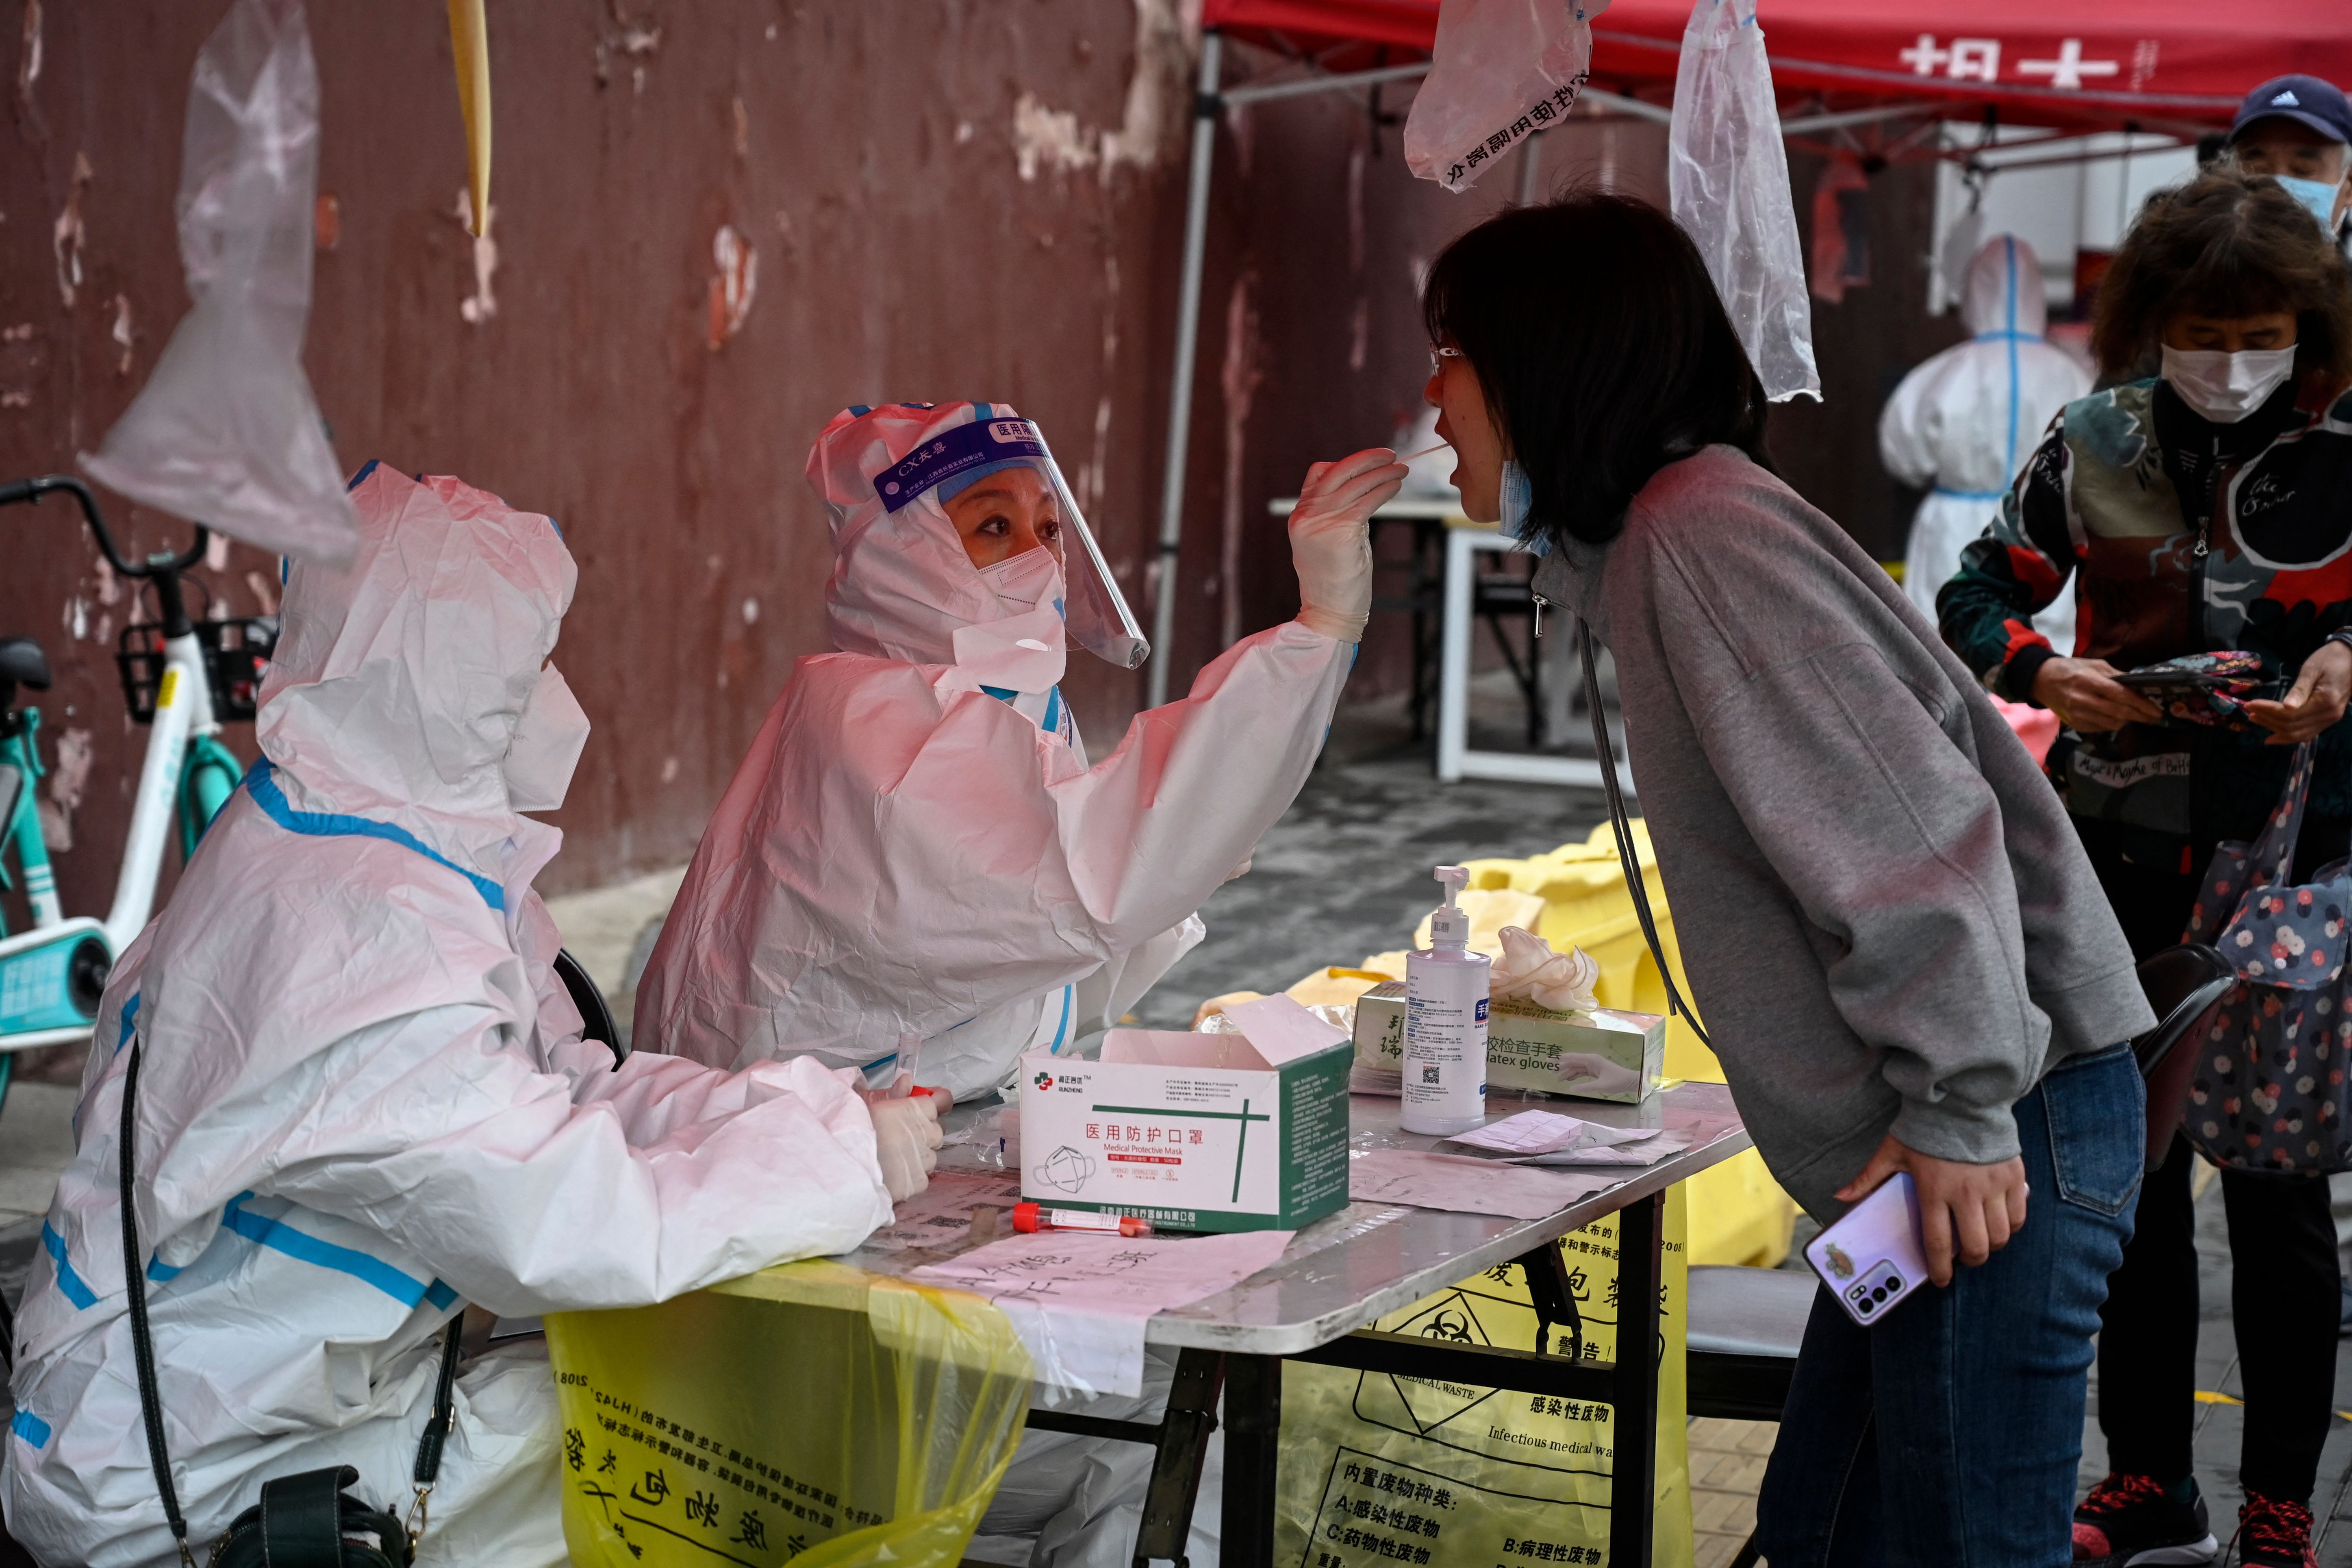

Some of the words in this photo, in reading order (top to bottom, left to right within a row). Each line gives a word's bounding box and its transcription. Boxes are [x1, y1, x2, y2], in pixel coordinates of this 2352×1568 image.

[1486, 1051, 1516, 1066] latex
[1520, 1057, 1560, 1071] gloves
[1086, 1123, 1203, 1145] 医用防护口罩
[1104, 1144, 1129, 1152] Medical
[1131, 1145, 1163, 1154] Protective
[1165, 1147, 1183, 1155] Mask
[1442, 1382, 1475, 1400] WASTE
[1530, 1396, 1609, 1422] 感染性废物
[1488, 1425, 1547, 1448] Infectious
[1549, 1440, 1592, 1454] medical
[1334, 1495, 1441, 1539] A:感染性废物
[1327, 1523, 1431, 1565] C:药物性废物
[1503, 1538, 1602, 1566] B:病理性废物
